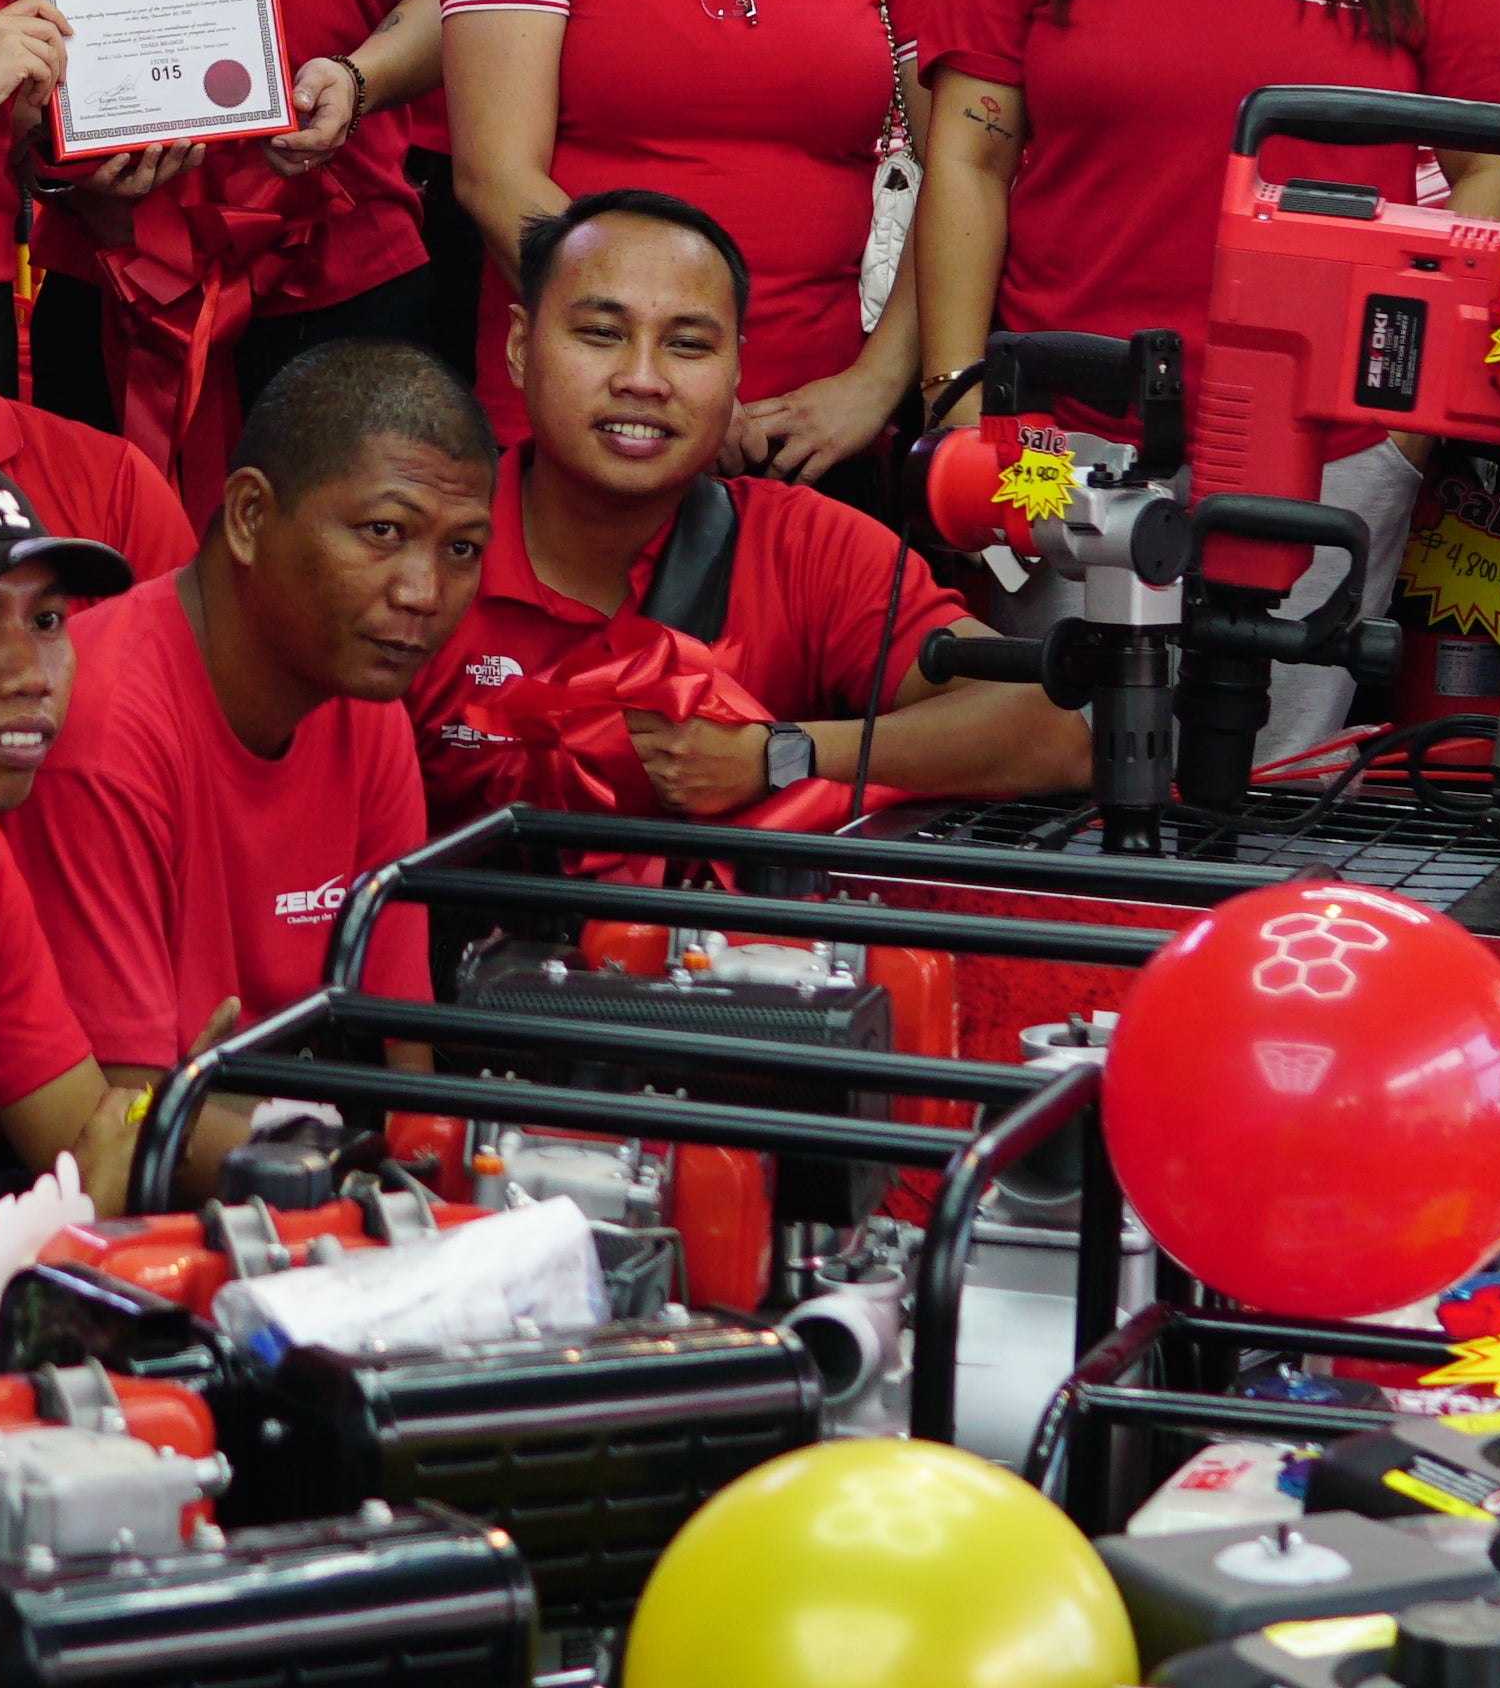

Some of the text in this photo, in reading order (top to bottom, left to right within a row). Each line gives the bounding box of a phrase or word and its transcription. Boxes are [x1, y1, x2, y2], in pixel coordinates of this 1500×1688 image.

[151, 65, 182, 82] 015
[1020, 426, 1065, 455] sale
[482, 655, 501, 665] THE
[465, 664, 501, 675] NORTH
[475, 675, 502, 686] FACE
